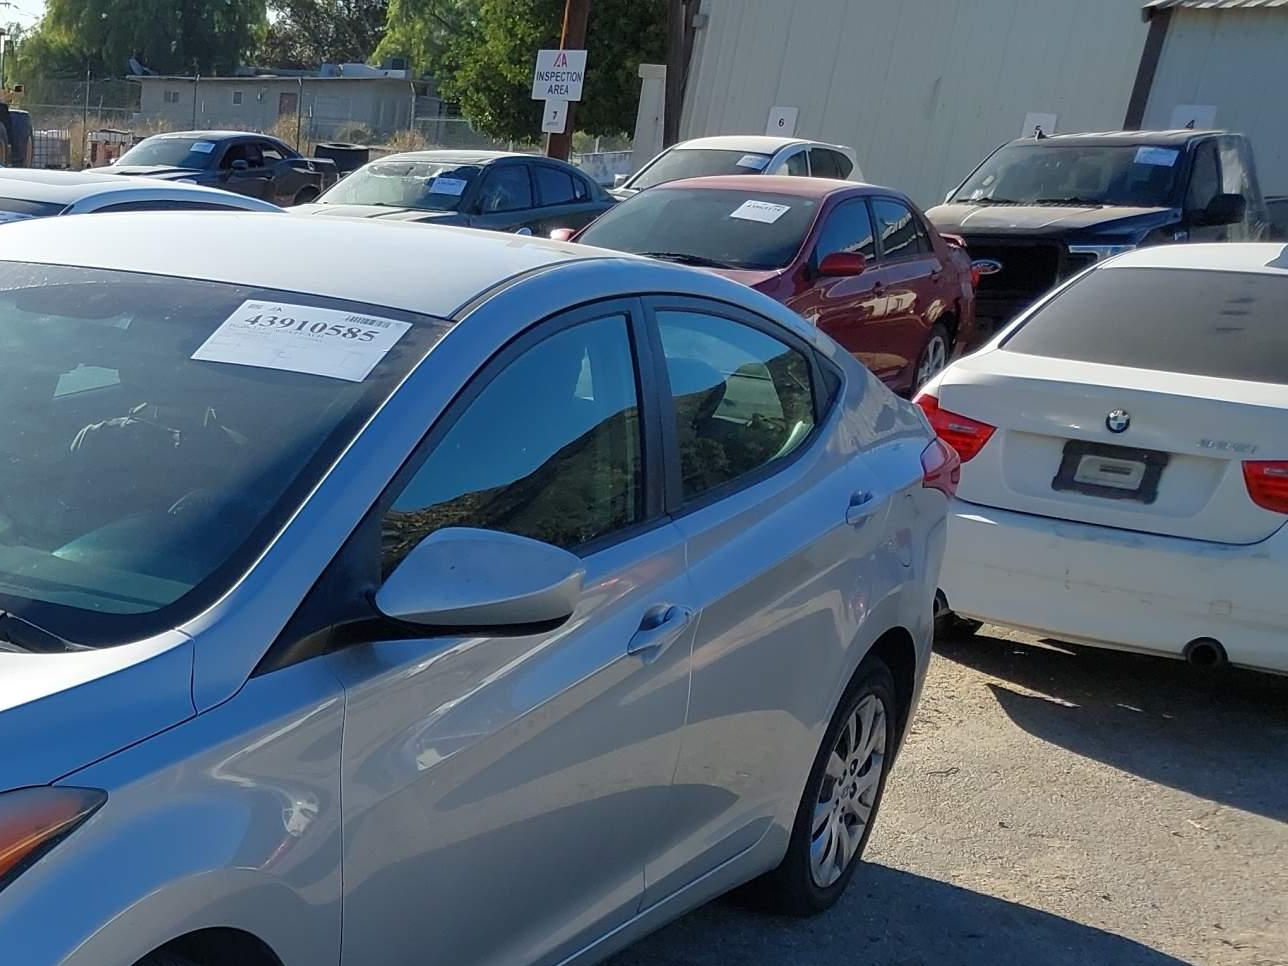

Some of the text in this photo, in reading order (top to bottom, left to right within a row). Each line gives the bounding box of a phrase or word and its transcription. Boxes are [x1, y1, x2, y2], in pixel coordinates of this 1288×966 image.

[536, 71, 583, 83] INSPECTION
[547, 84, 569, 95] AREA
[552, 110, 558, 120] 7
[778, 117, 785, 127] 6
[243, 313, 381, 343] 43910585
